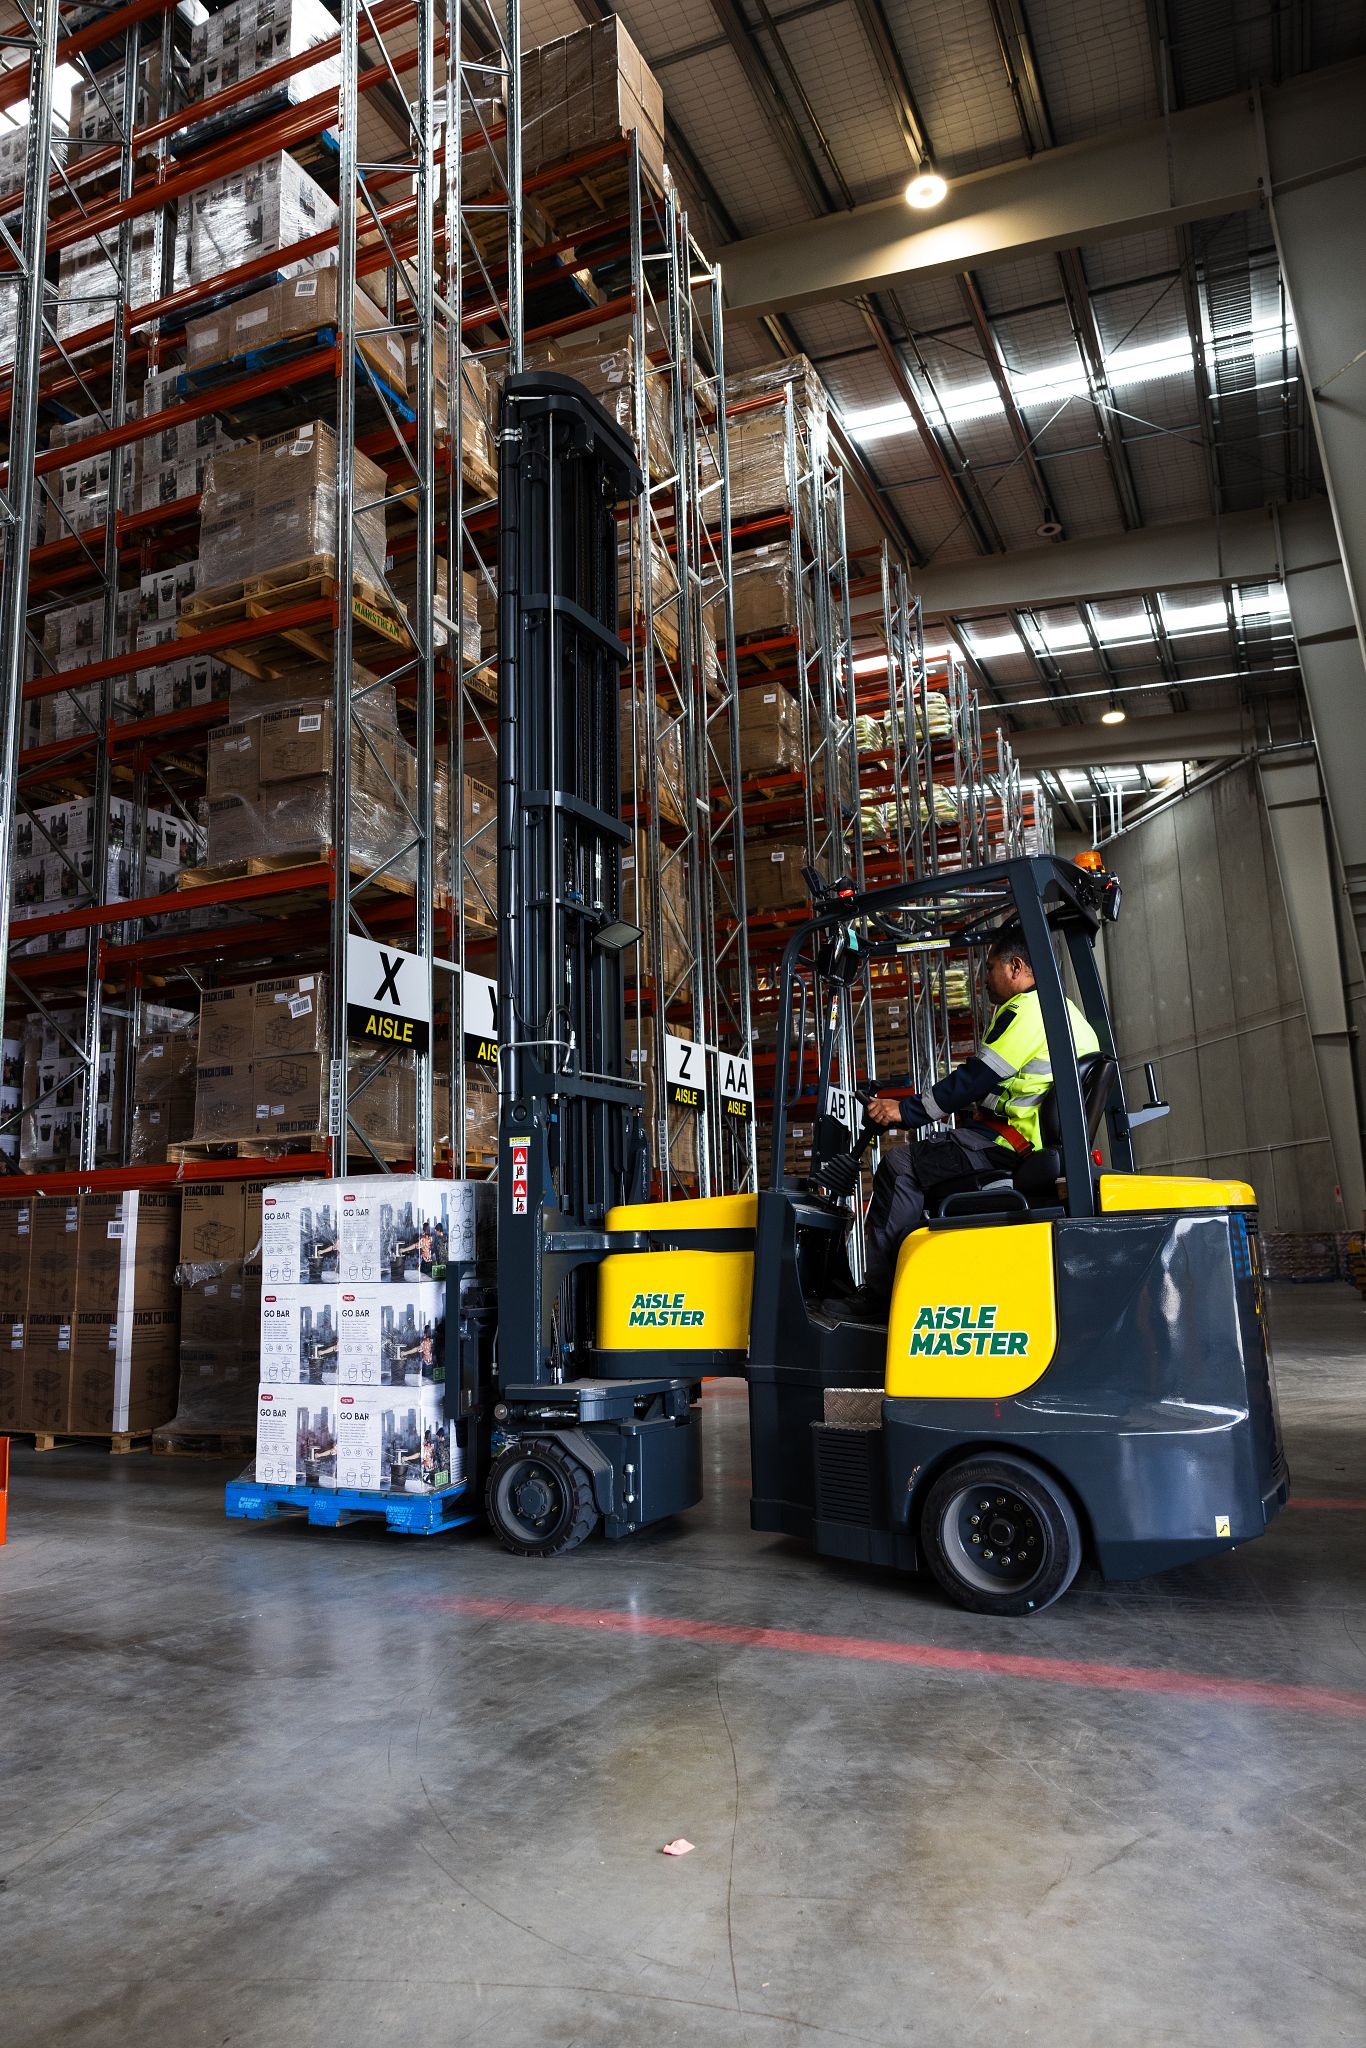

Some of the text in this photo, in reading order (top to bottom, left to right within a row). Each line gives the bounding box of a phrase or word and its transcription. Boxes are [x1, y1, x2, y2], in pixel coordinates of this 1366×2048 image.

[374, 951, 405, 1006] X
[365, 1015, 413, 1042] AISLE
[477, 1041, 498, 1062] AIS
[679, 1045, 691, 1080] Z
[725, 1060, 748, 1095] AA
[675, 1088, 697, 1105] AISLE
[830, 1092, 846, 1119] AB
[728, 1101, 746, 1116] AISLE
[140, 1194, 159, 1207] TACK
[185, 1186, 203, 1196] STACK
[133, 1313, 153, 1325] TACK
[629, 1310, 704, 1326] MASTER
[909, 1332, 1028, 1355] MASTER
[273, 1409, 287, 1417] BAR
